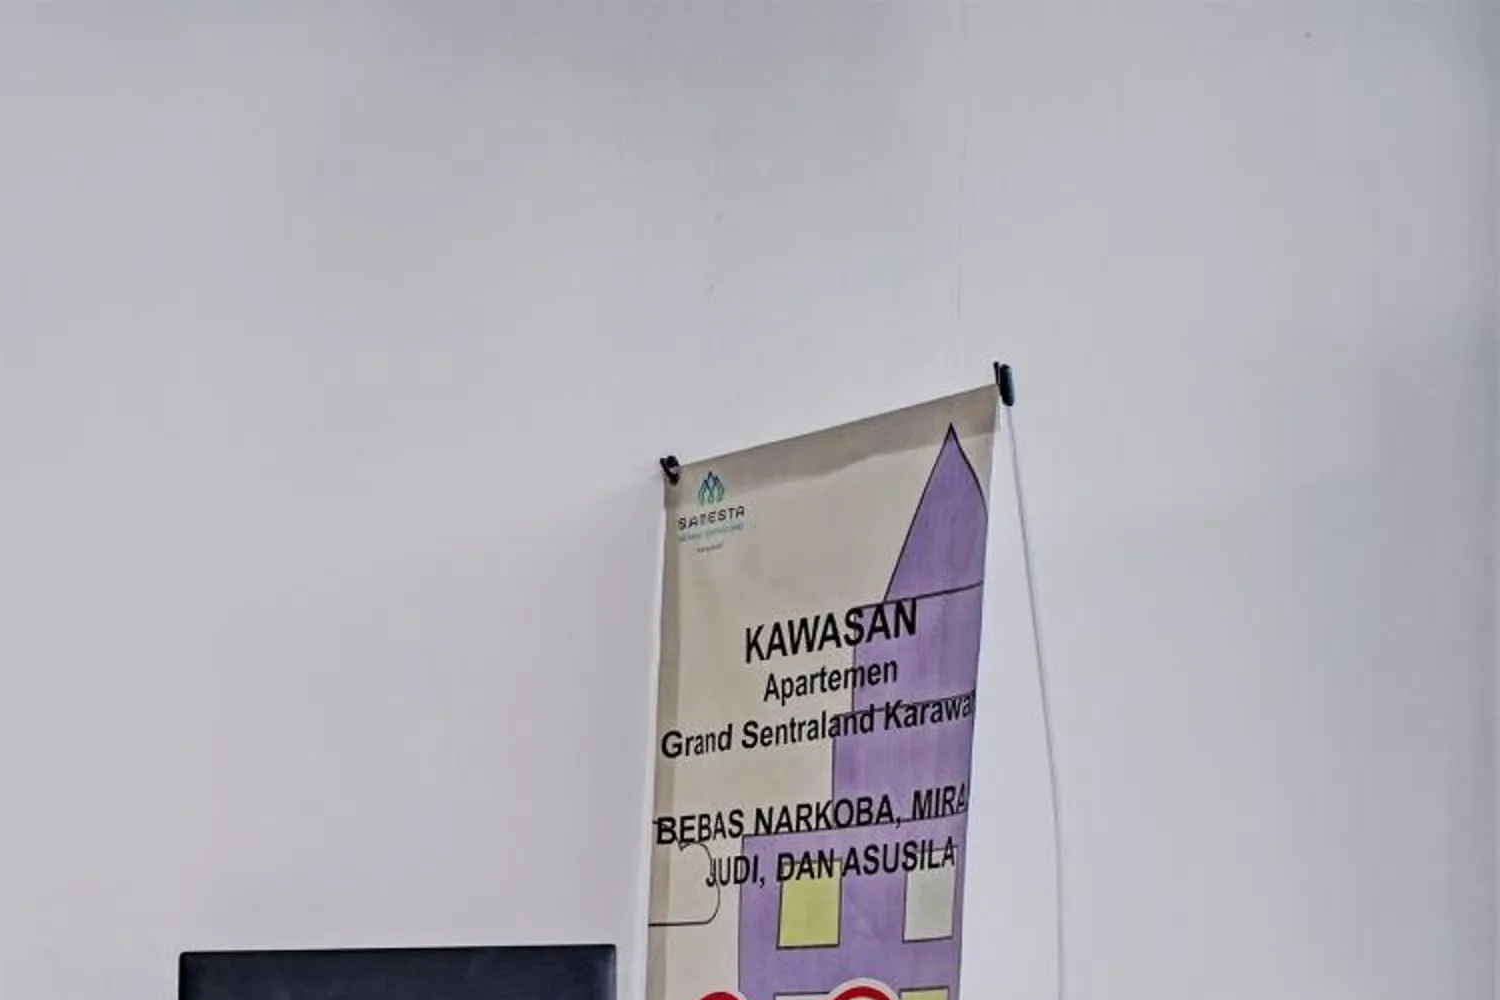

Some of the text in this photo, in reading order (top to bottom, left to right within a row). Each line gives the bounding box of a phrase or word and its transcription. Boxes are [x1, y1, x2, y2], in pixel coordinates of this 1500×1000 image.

[744, 598, 918, 664] KAWASAN
[763, 660, 898, 706] Apartemen
[660, 714, 733, 759] Grand
[741, 703, 875, 750] Sentraland
[655, 808, 744, 845] BEBAS
[754, 794, 902, 836] NARKOBA,
[705, 836, 956, 888] JUDI, DAN ASUSILA
